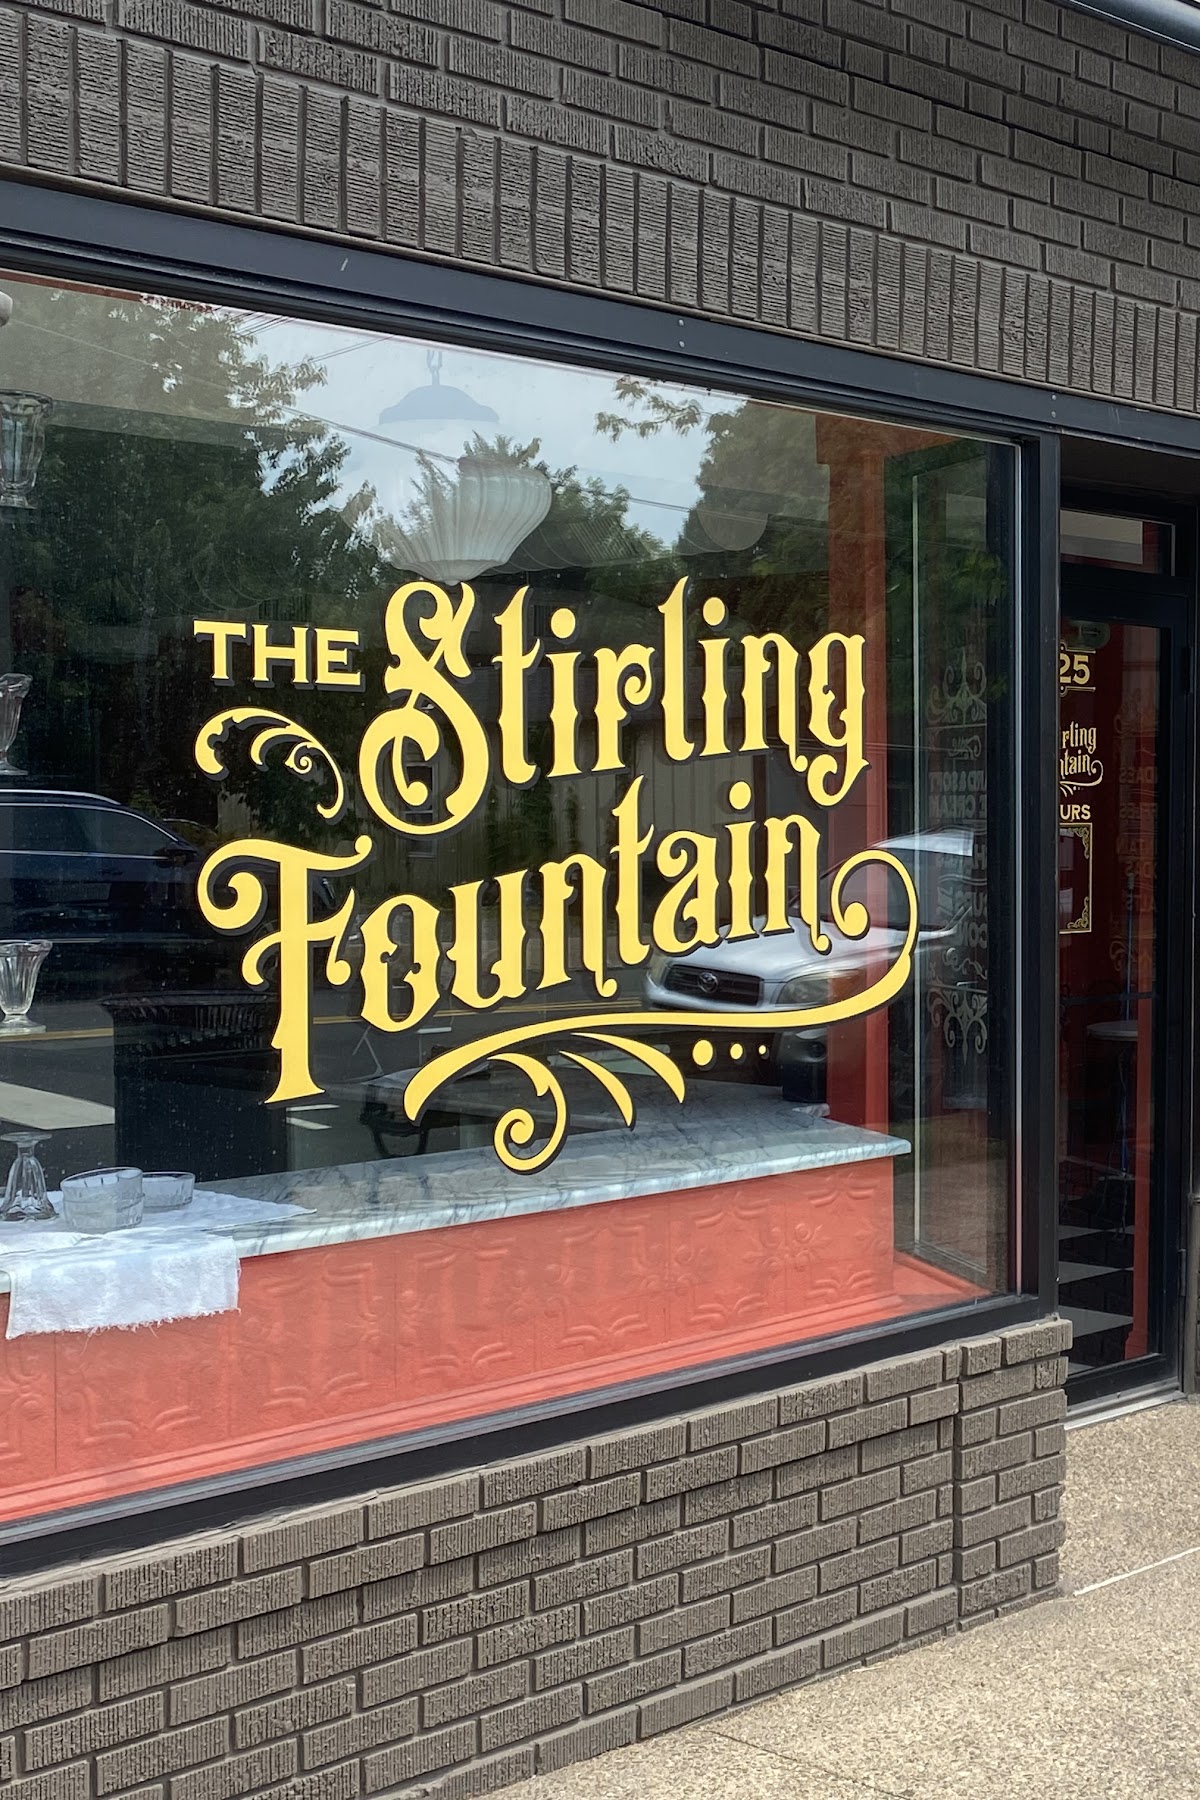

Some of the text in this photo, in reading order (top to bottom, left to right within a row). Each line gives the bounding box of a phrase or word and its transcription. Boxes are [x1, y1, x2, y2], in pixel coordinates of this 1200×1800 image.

[194, 576, 867, 834] THE Stirling
[196, 775, 832, 1106] Fountain
